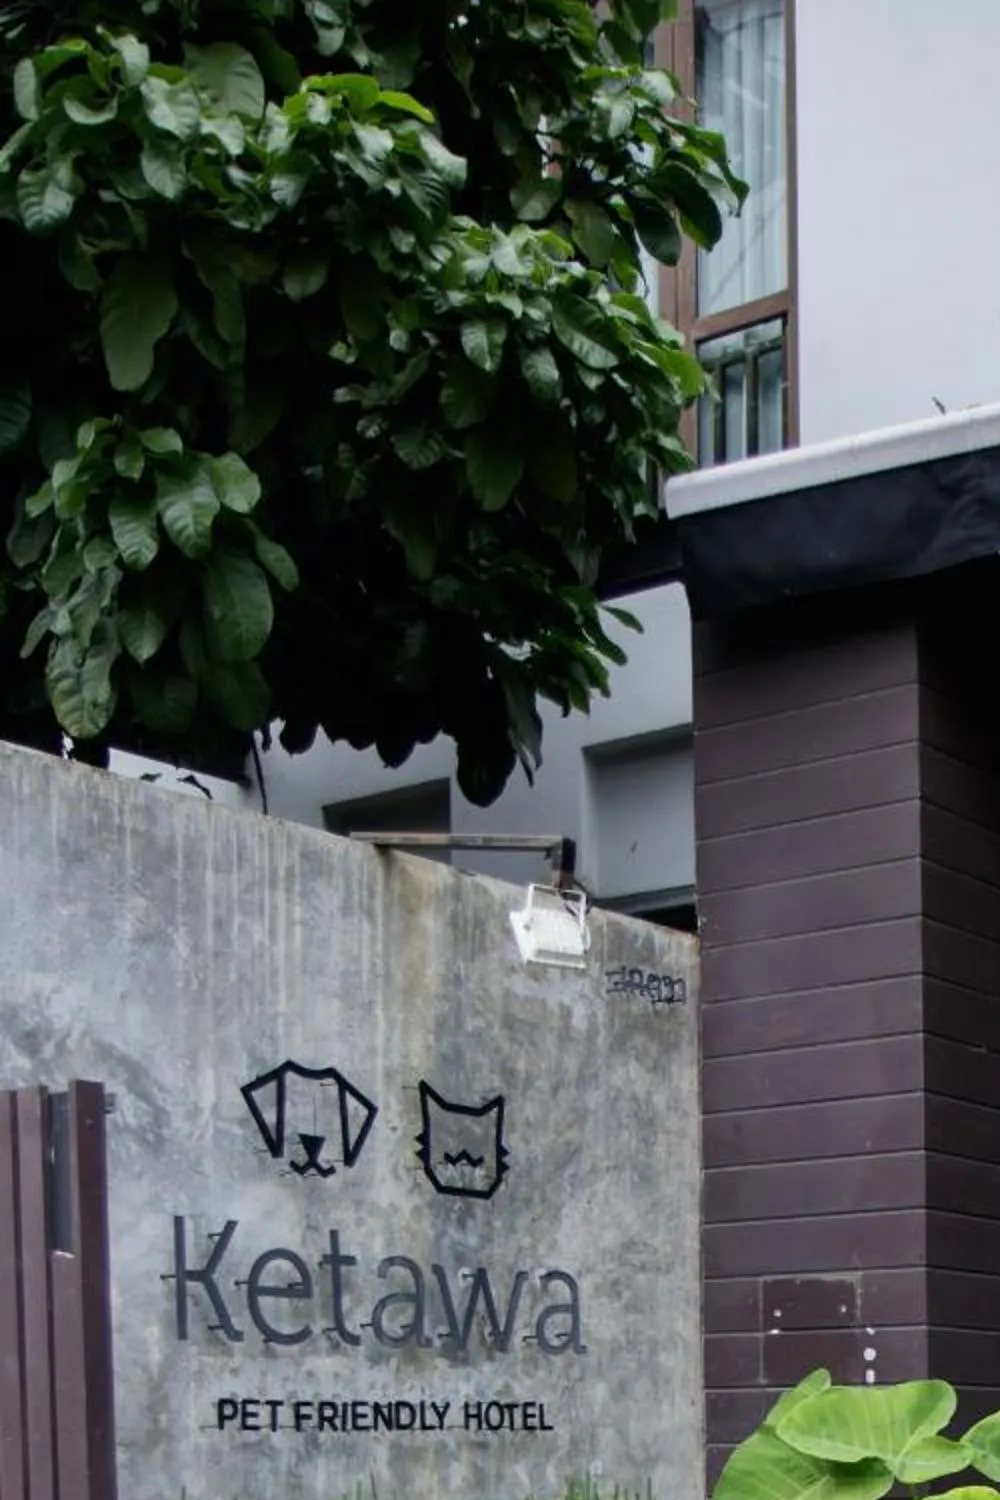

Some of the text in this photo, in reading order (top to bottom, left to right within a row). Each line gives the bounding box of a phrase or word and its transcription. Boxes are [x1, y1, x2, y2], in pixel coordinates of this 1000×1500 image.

[173, 1214, 588, 1356] Ketawa
[217, 1398, 555, 1433] PET FRIENDLY HOTEL
